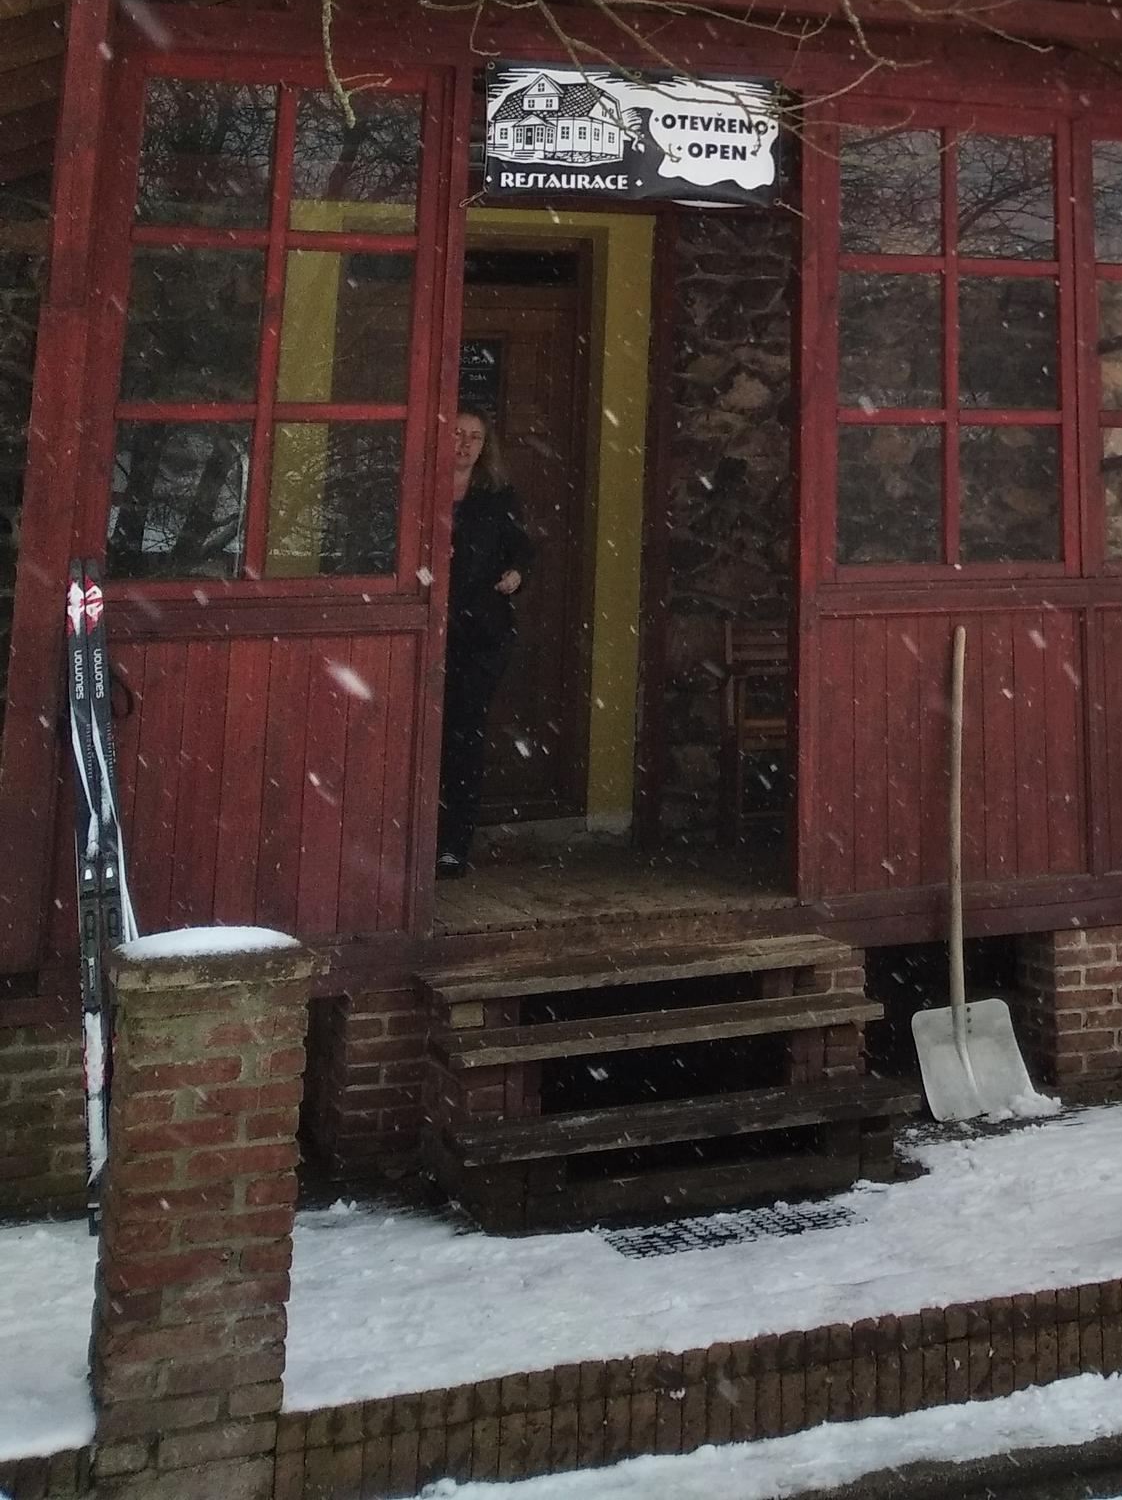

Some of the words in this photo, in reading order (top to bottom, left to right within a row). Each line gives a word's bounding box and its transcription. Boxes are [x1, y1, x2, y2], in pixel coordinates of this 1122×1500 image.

[661, 111, 768, 135] OTEVŘENO
[687, 142, 747, 161] OPEN
[500, 172, 629, 190] RESTAURACE
